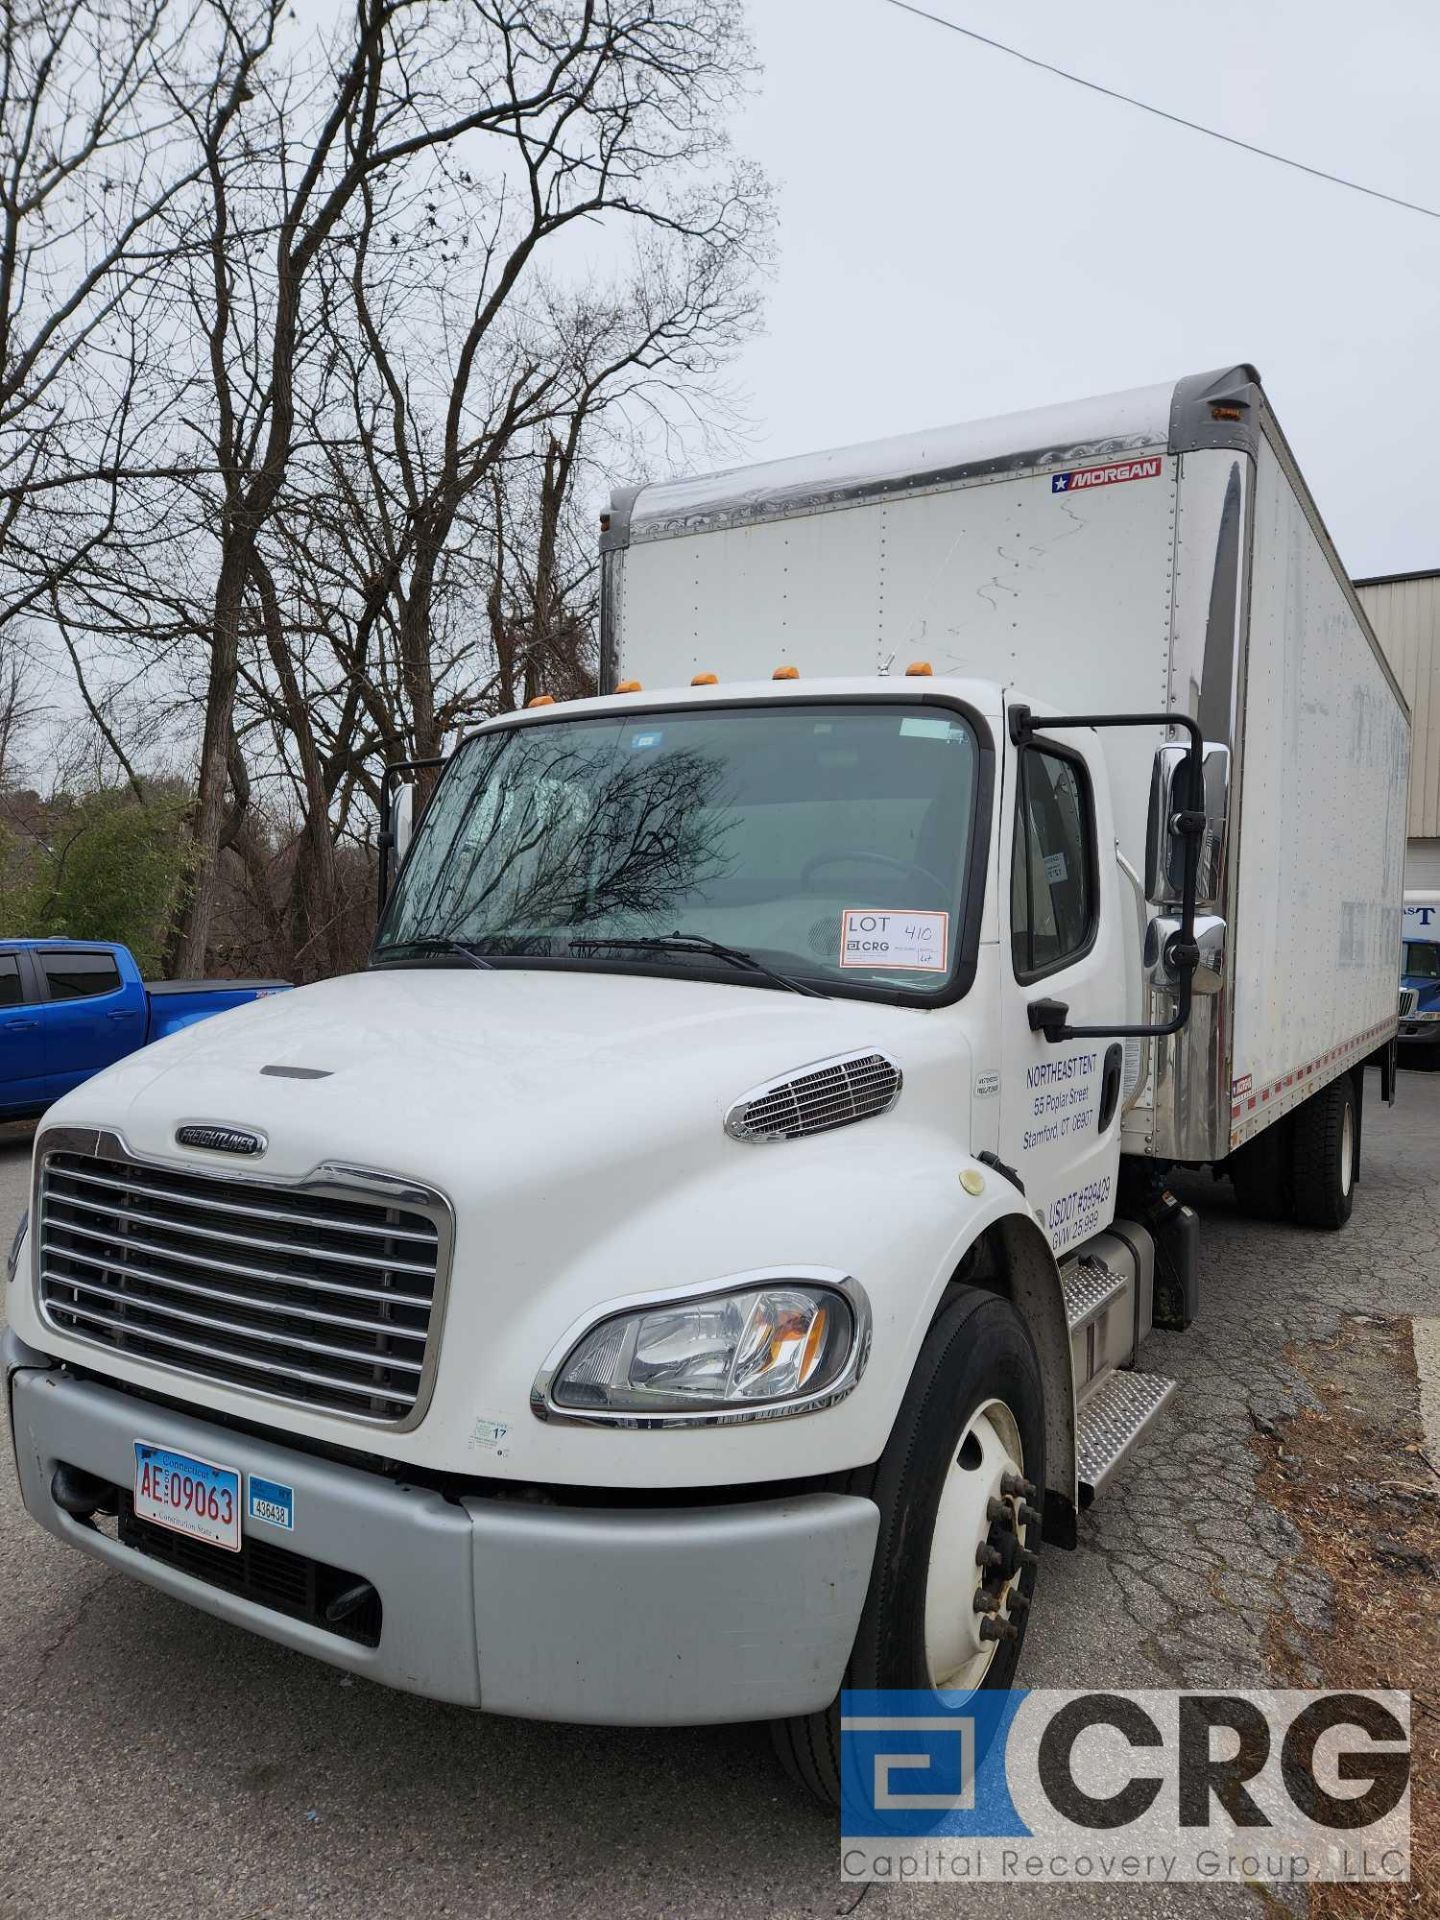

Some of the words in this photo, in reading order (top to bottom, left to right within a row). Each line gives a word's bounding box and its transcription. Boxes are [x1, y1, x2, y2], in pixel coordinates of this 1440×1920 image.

[1071, 460, 1157, 488] MORGAN
[849, 916, 891, 932] LOT
[905, 925, 932, 941] 410
[862, 941, 889, 952] CRG
[1026, 1057, 1077, 1089] NORTHEAST
[1078, 1054, 1097, 1076] TENT
[1034, 1096, 1044, 1116] 55
[1046, 1092, 1069, 1114] Poplar
[1069, 1085, 1089, 1104] Street
[181, 1128, 256, 1152] FREIGHTLINER
[1023, 1121, 1058, 1150] Stamford,
[1061, 1117, 1070, 1136] CT
[1072, 1109, 1093, 1131] 06907
[1049, 1191, 1077, 1229] USDOT
[1052, 1226, 1069, 1250] GVW
[493, 1428, 506, 1439] 17
[162, 1455, 210, 1479] Connecticut
[256, 1500, 285, 1522] 436438
